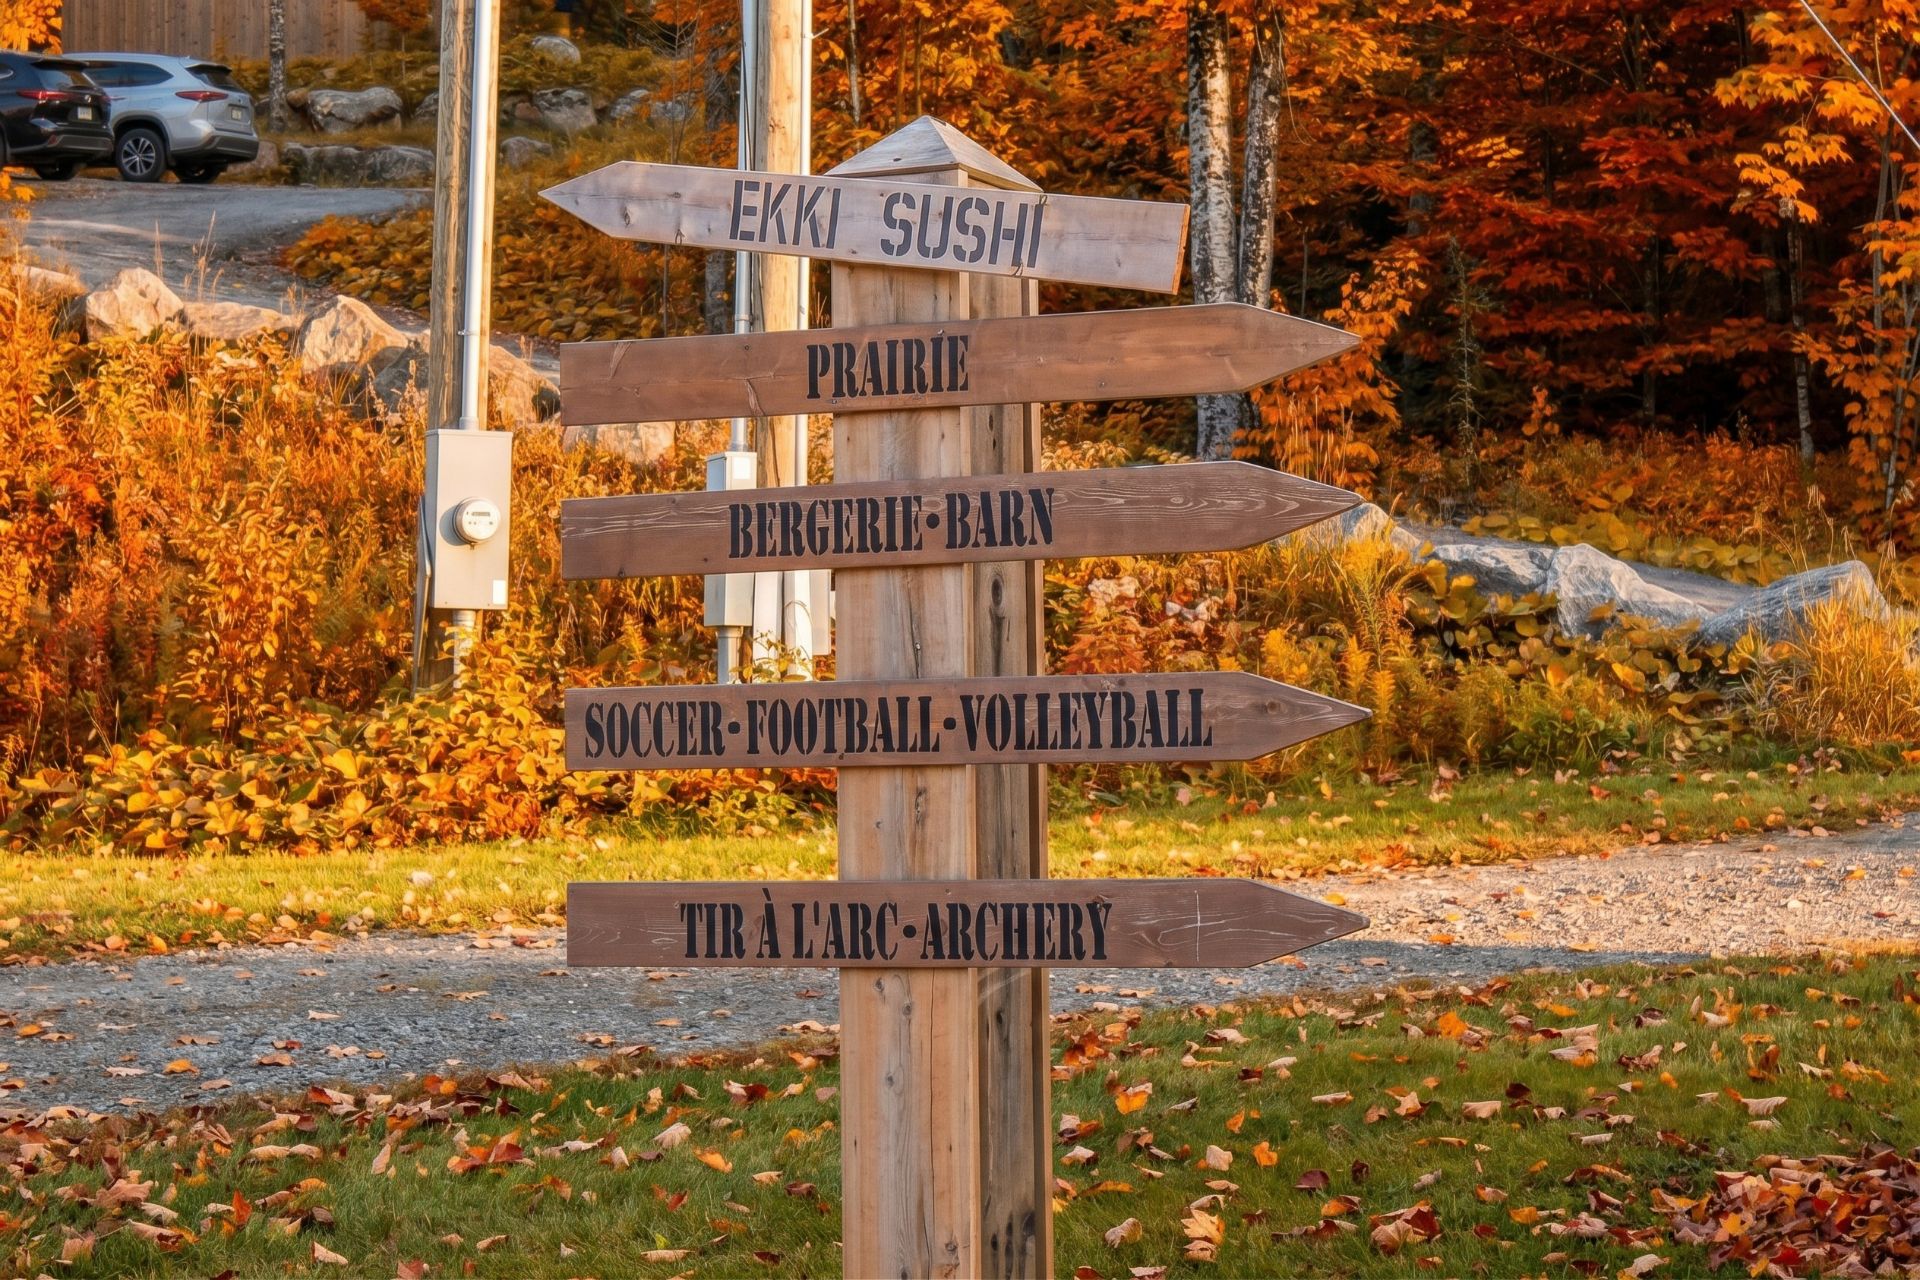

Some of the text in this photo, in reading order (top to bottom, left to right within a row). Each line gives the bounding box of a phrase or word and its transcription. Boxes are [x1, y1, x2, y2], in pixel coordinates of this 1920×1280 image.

[729, 180, 1043, 268] EKKI SUSHI
[806, 335, 969, 399] PRAIRIE
[680, 903, 746, 959] TIR
[756, 888, 781, 959] À
